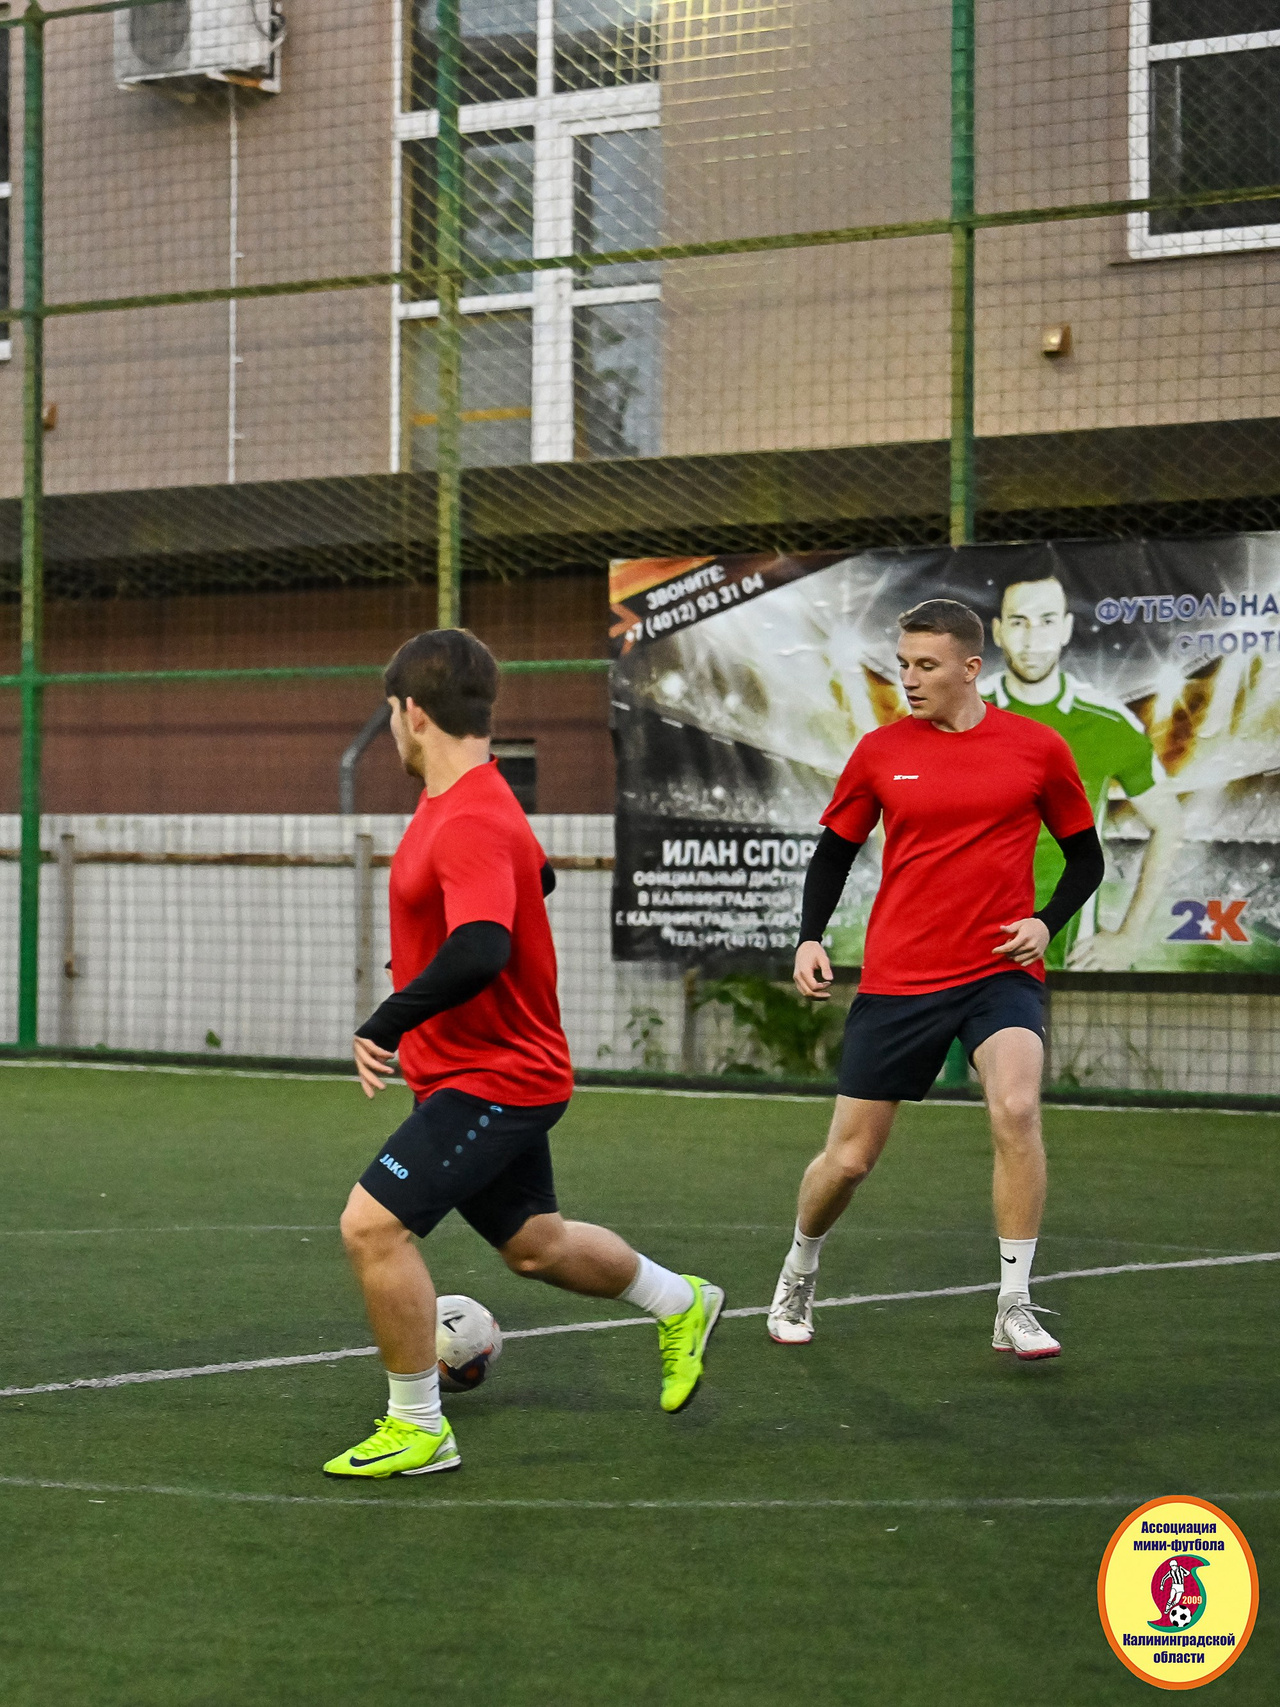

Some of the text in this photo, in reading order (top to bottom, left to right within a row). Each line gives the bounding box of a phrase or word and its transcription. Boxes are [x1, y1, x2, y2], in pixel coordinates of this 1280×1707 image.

[646, 601, 697, 639] (4012)
[696, 591, 719, 613] 93
[719, 582, 740, 604] 31
[741, 572, 764, 595] 04
[662, 839, 818, 867] ИЛАН СПОР
[1166, 899, 1250, 943] 2K
[379, 1153, 409, 1180] JAKO
